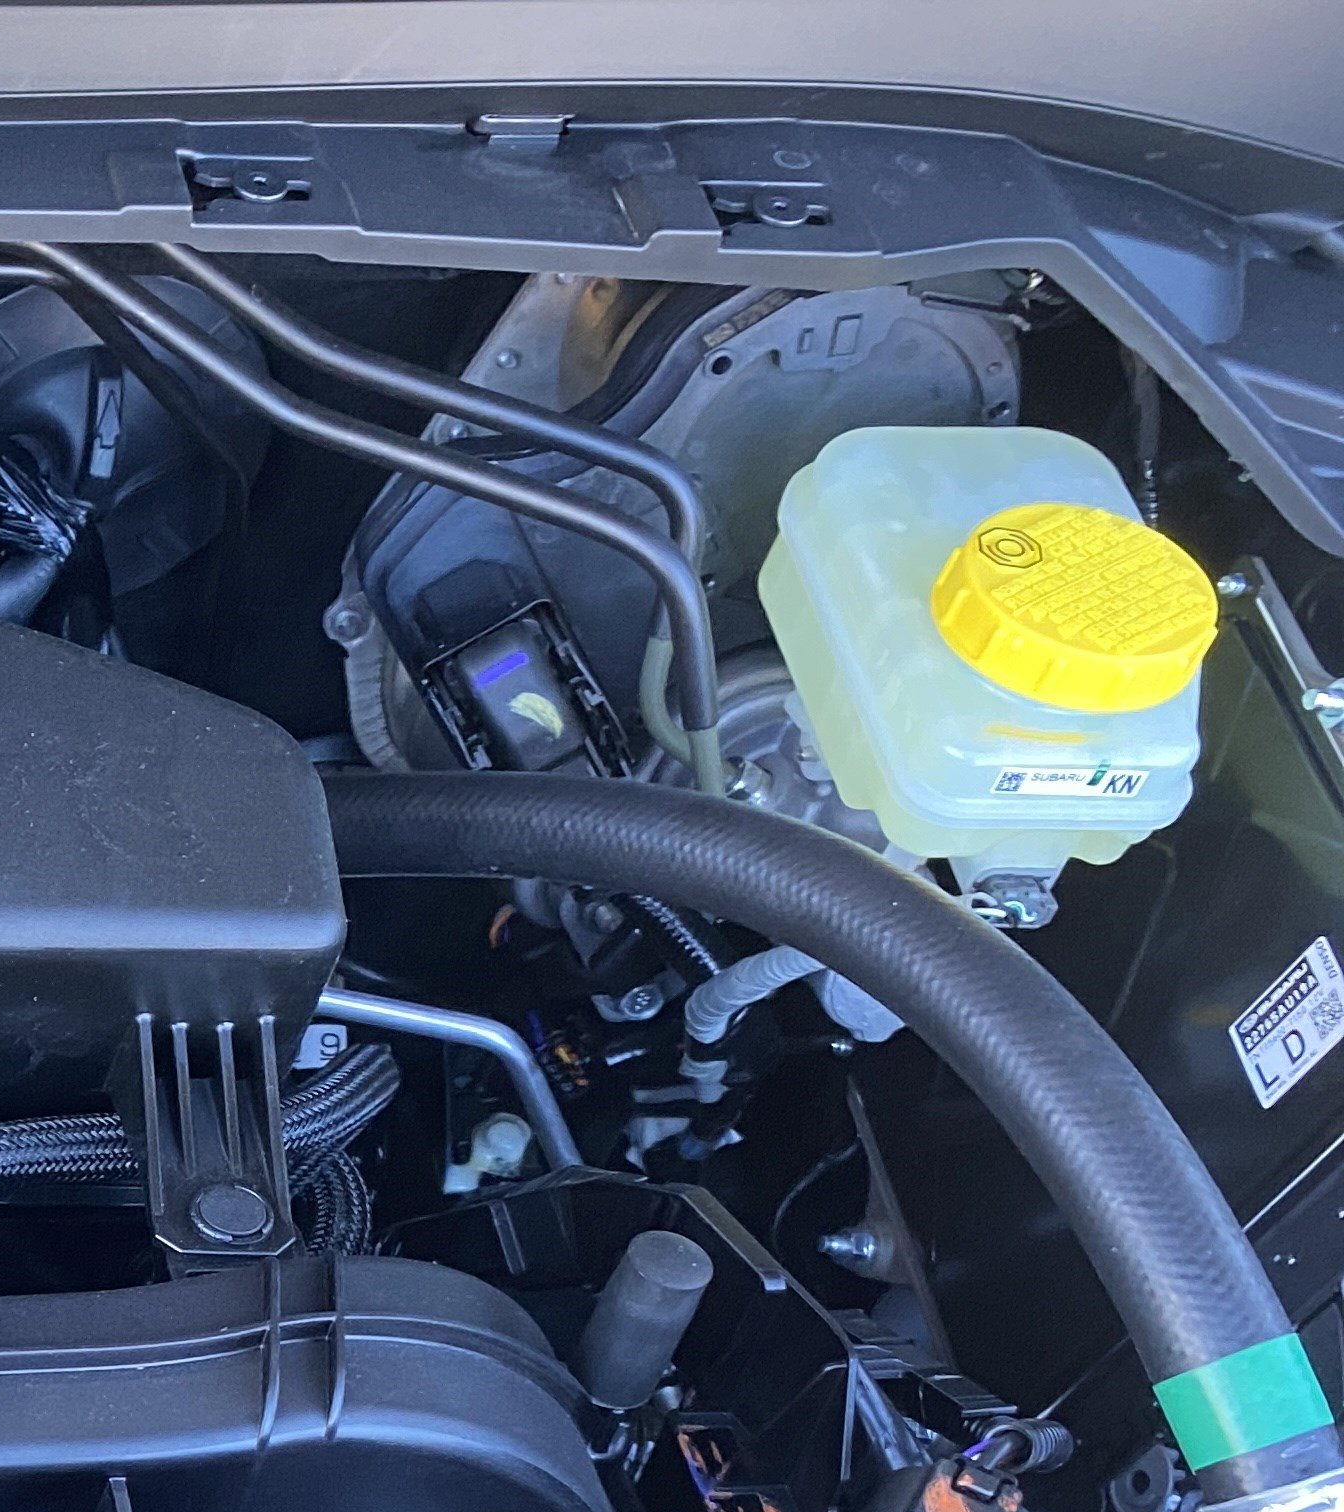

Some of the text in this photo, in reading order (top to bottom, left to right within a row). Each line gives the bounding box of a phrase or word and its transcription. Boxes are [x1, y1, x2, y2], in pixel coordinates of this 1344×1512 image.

[1030, 772, 1086, 782] SUBARU
[1102, 774, 1142, 794] KN
[1256, 962, 1308, 1017] SUBARU
[1254, 1062, 1280, 1091] L
[1281, 1028, 1306, 1065] D
